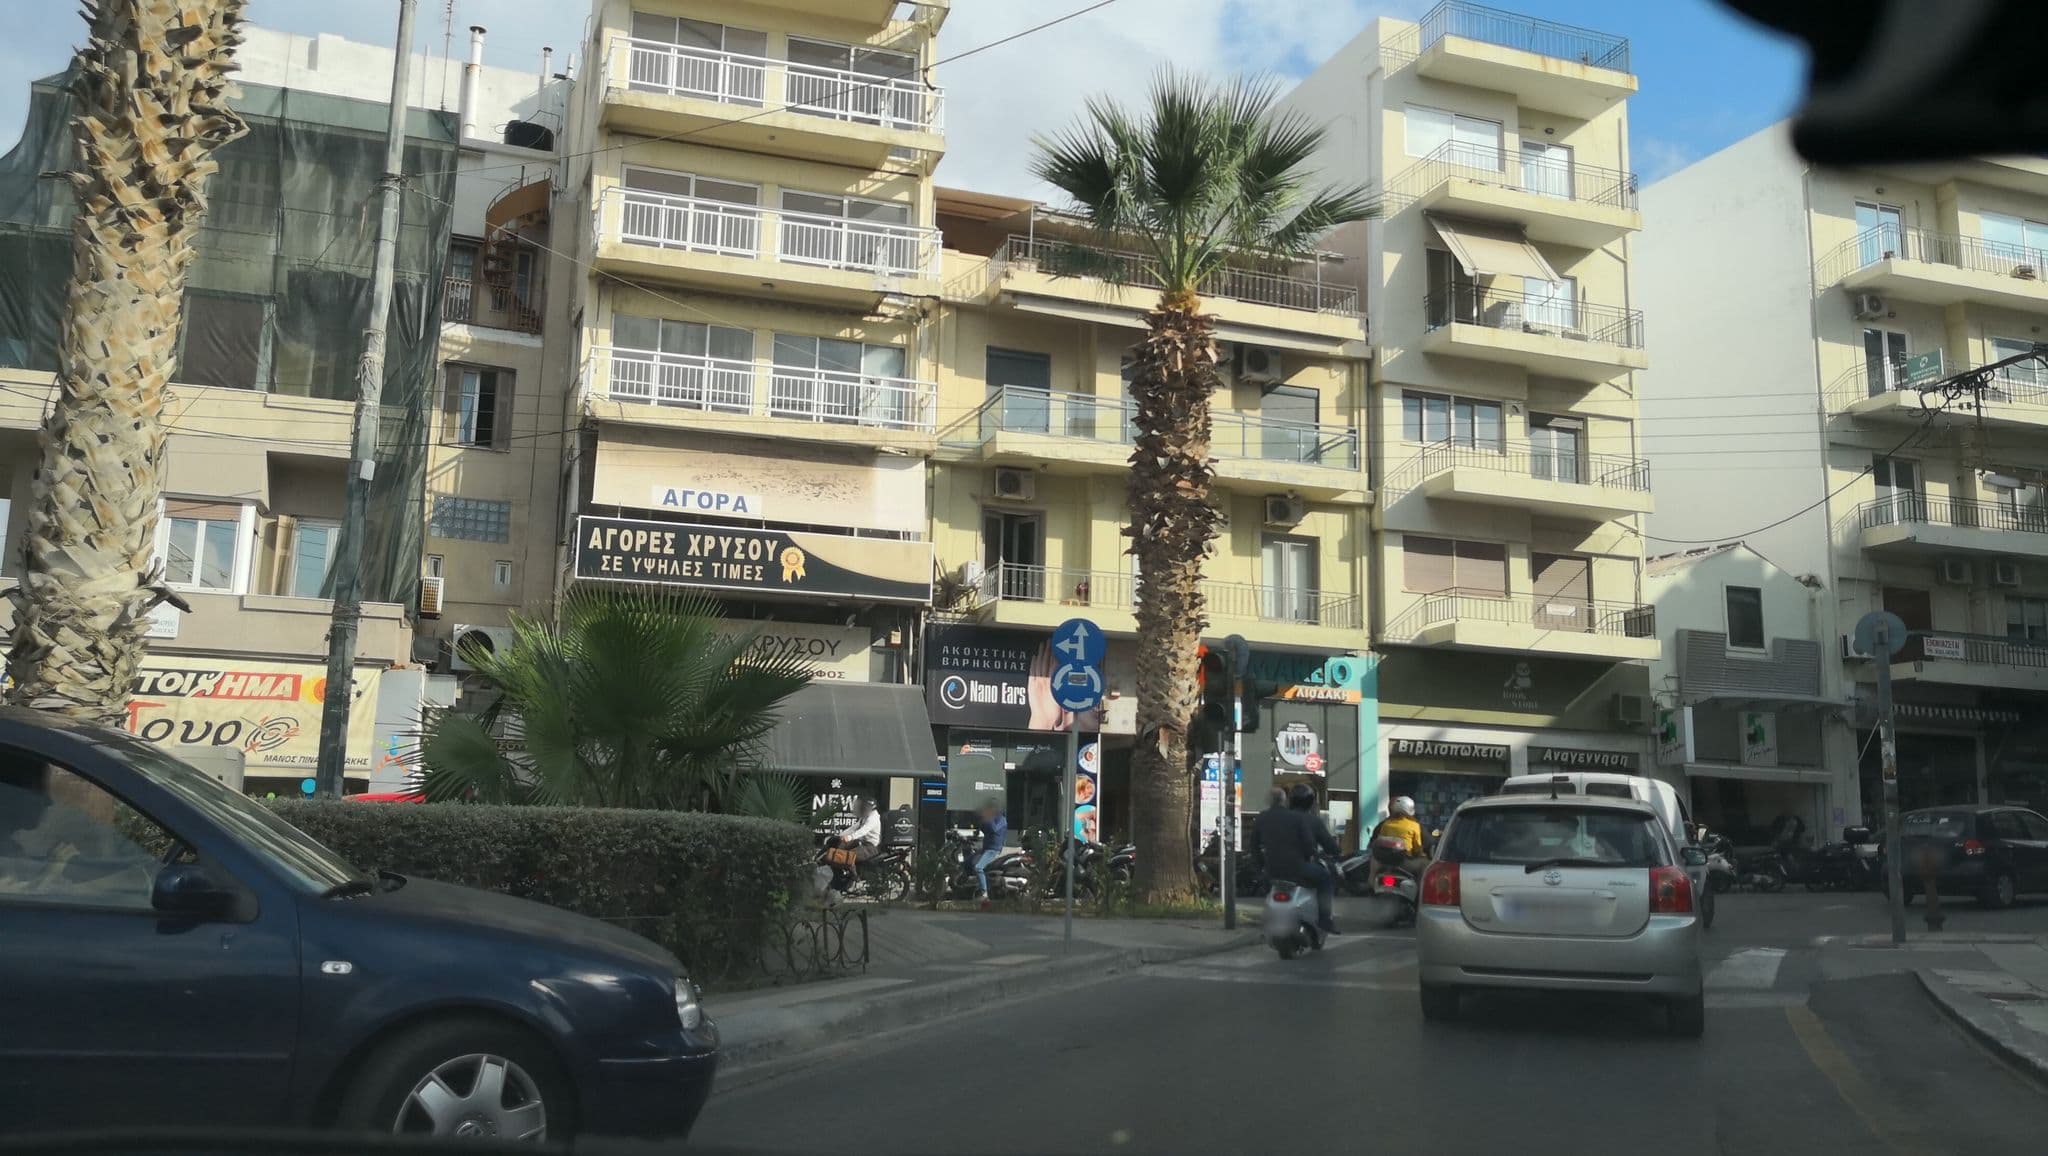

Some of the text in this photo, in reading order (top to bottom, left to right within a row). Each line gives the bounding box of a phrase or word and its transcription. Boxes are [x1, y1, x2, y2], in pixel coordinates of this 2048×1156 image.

[662, 488, 748, 513] ΑΓΟΡΑ
[588, 526, 778, 562] ΑΓΟΡΕΣ ΧΡΥΣΟΥ
[601, 554, 765, 581] ΣΕ ΥΨΗΛΕΣ ΤΙΜΕΣ
[942, 645, 1026, 660] ΑΚΟΥΣΤΙΚΑ
[942, 656, 1026, 672] ΒΑΡΗΚΟΙΑΣ
[136, 671, 294, 698] ΤΟΙΧΗΜΑ
[970, 680, 1026, 705] Nano Ears
[1295, 688, 1350, 701] ΛΙΟΔΑΚΗ
[264, 754, 297, 764] ΜΑΝΟΣ
